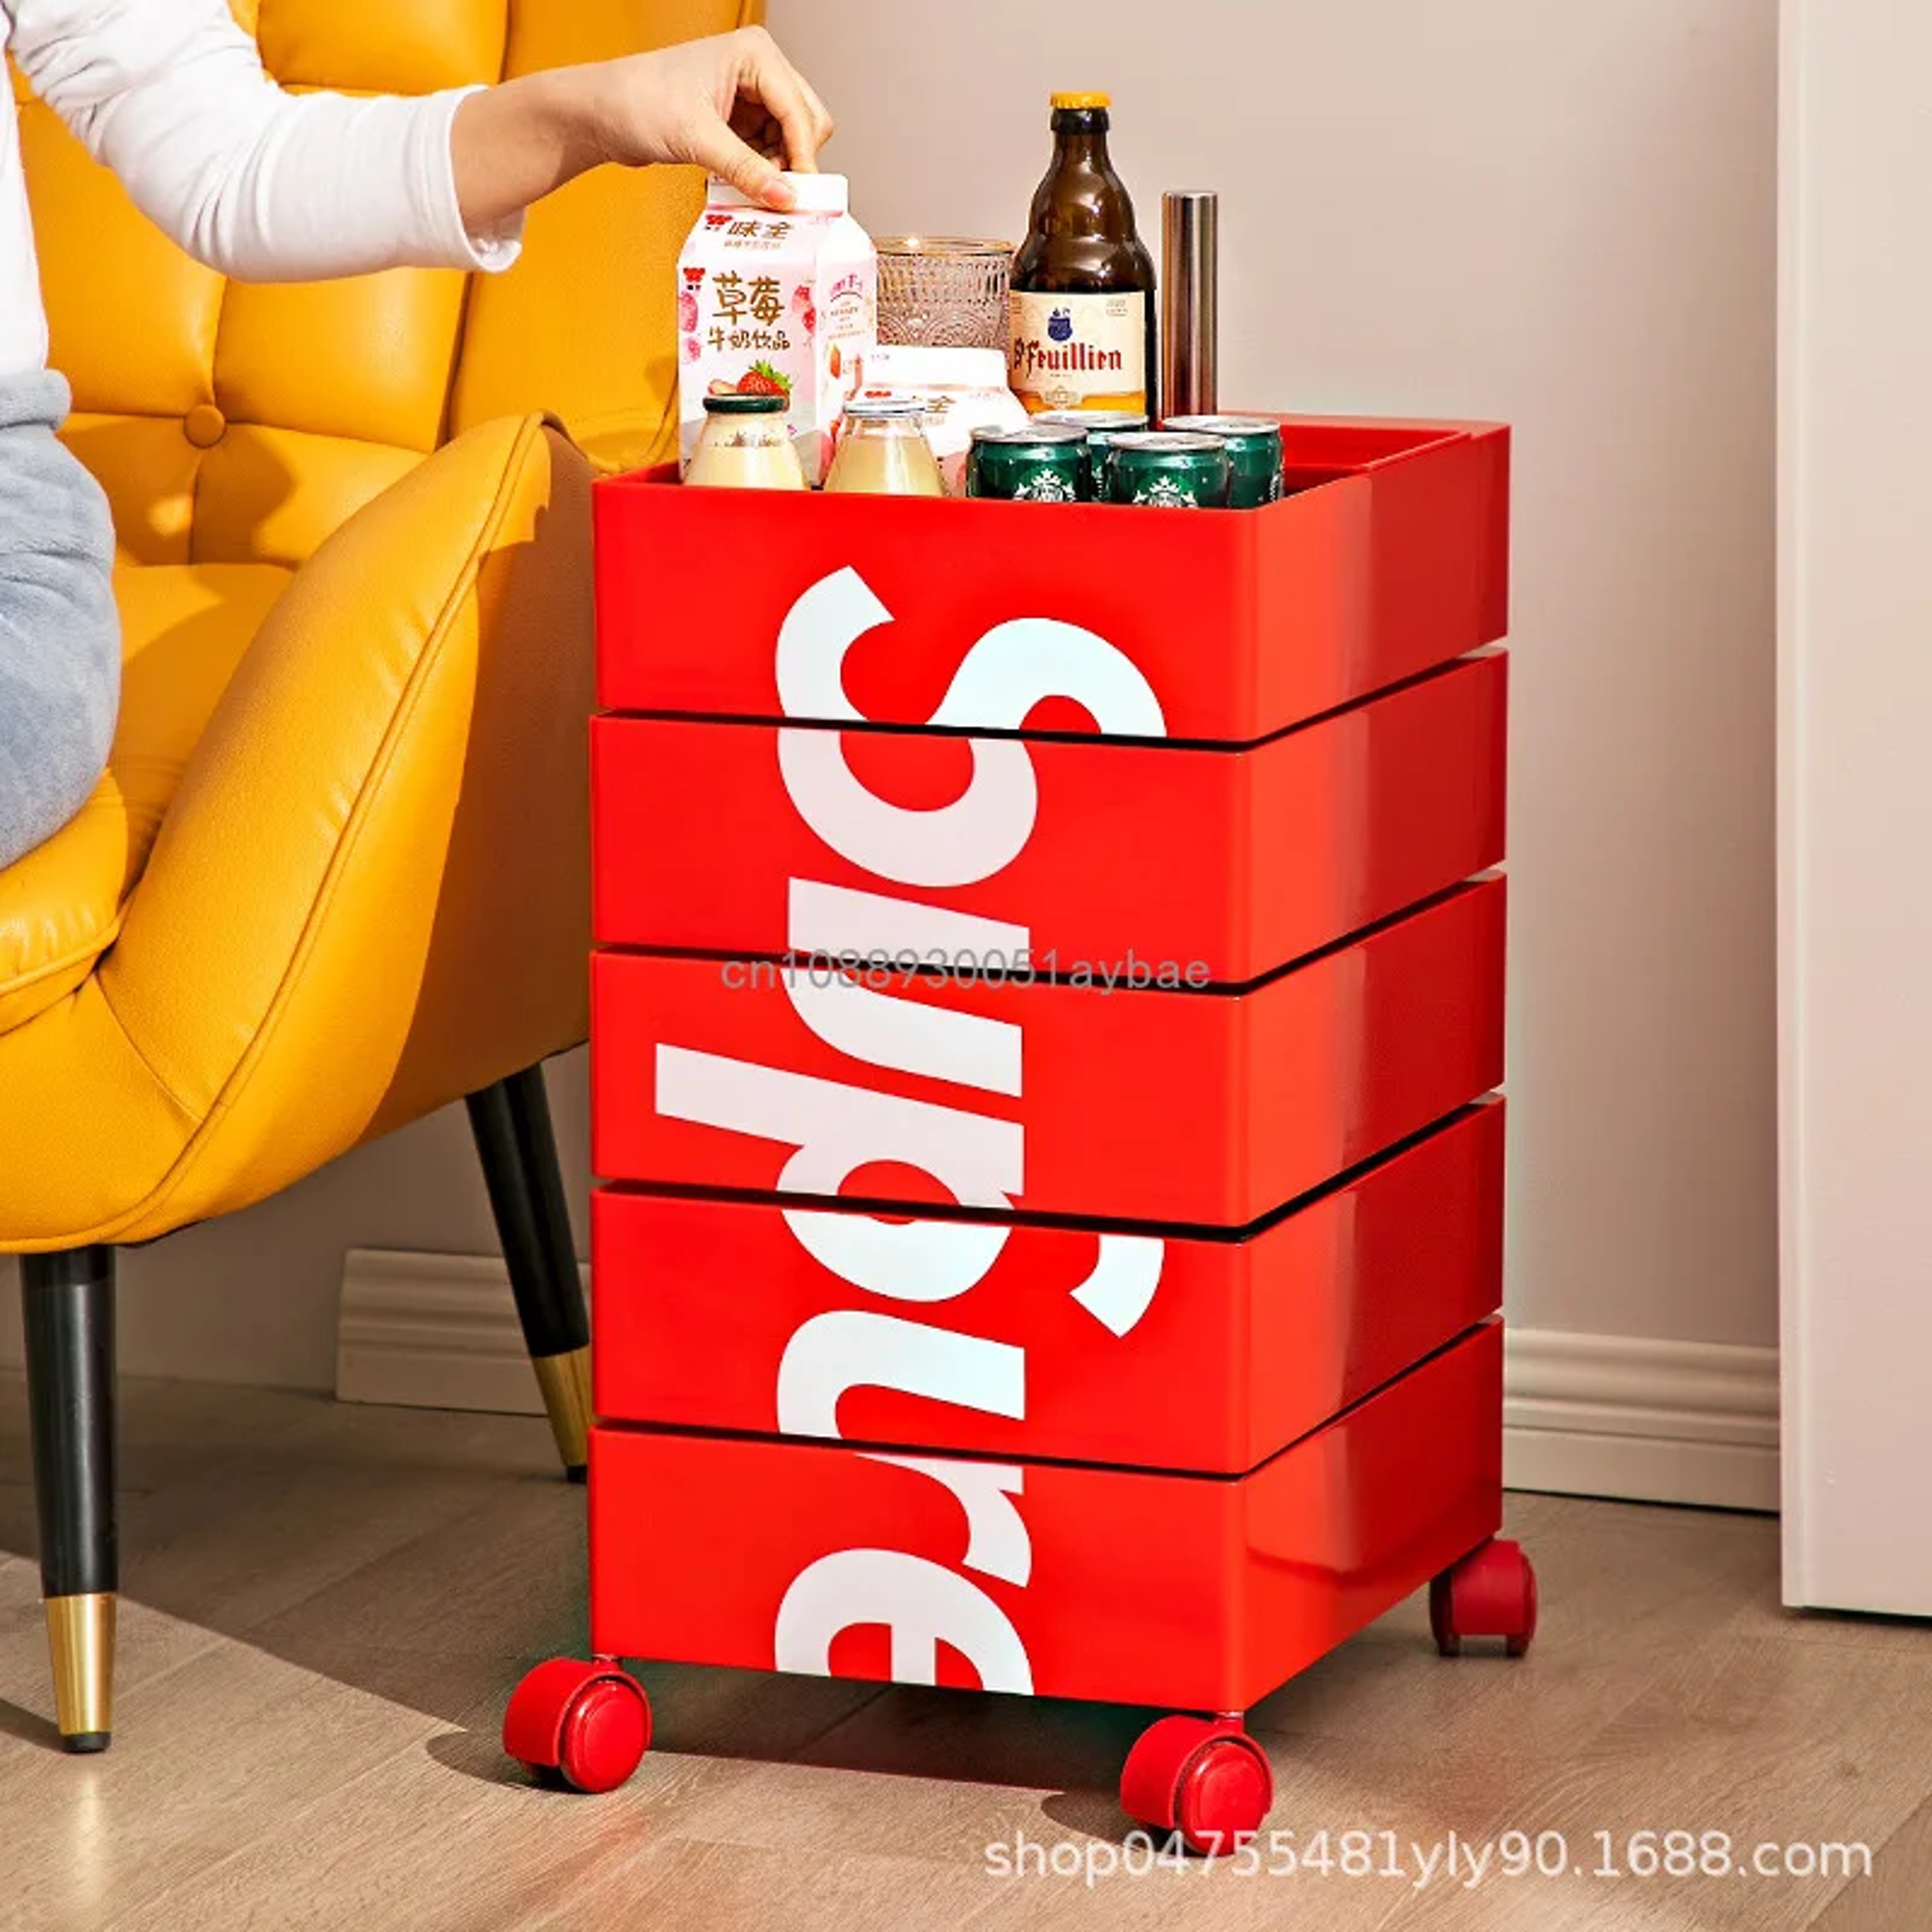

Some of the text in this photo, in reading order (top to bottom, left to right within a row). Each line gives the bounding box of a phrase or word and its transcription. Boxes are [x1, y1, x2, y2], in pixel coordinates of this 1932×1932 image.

[712, 270, 785, 326] 草莓
[707, 327, 790, 352] 牛奶饮品
